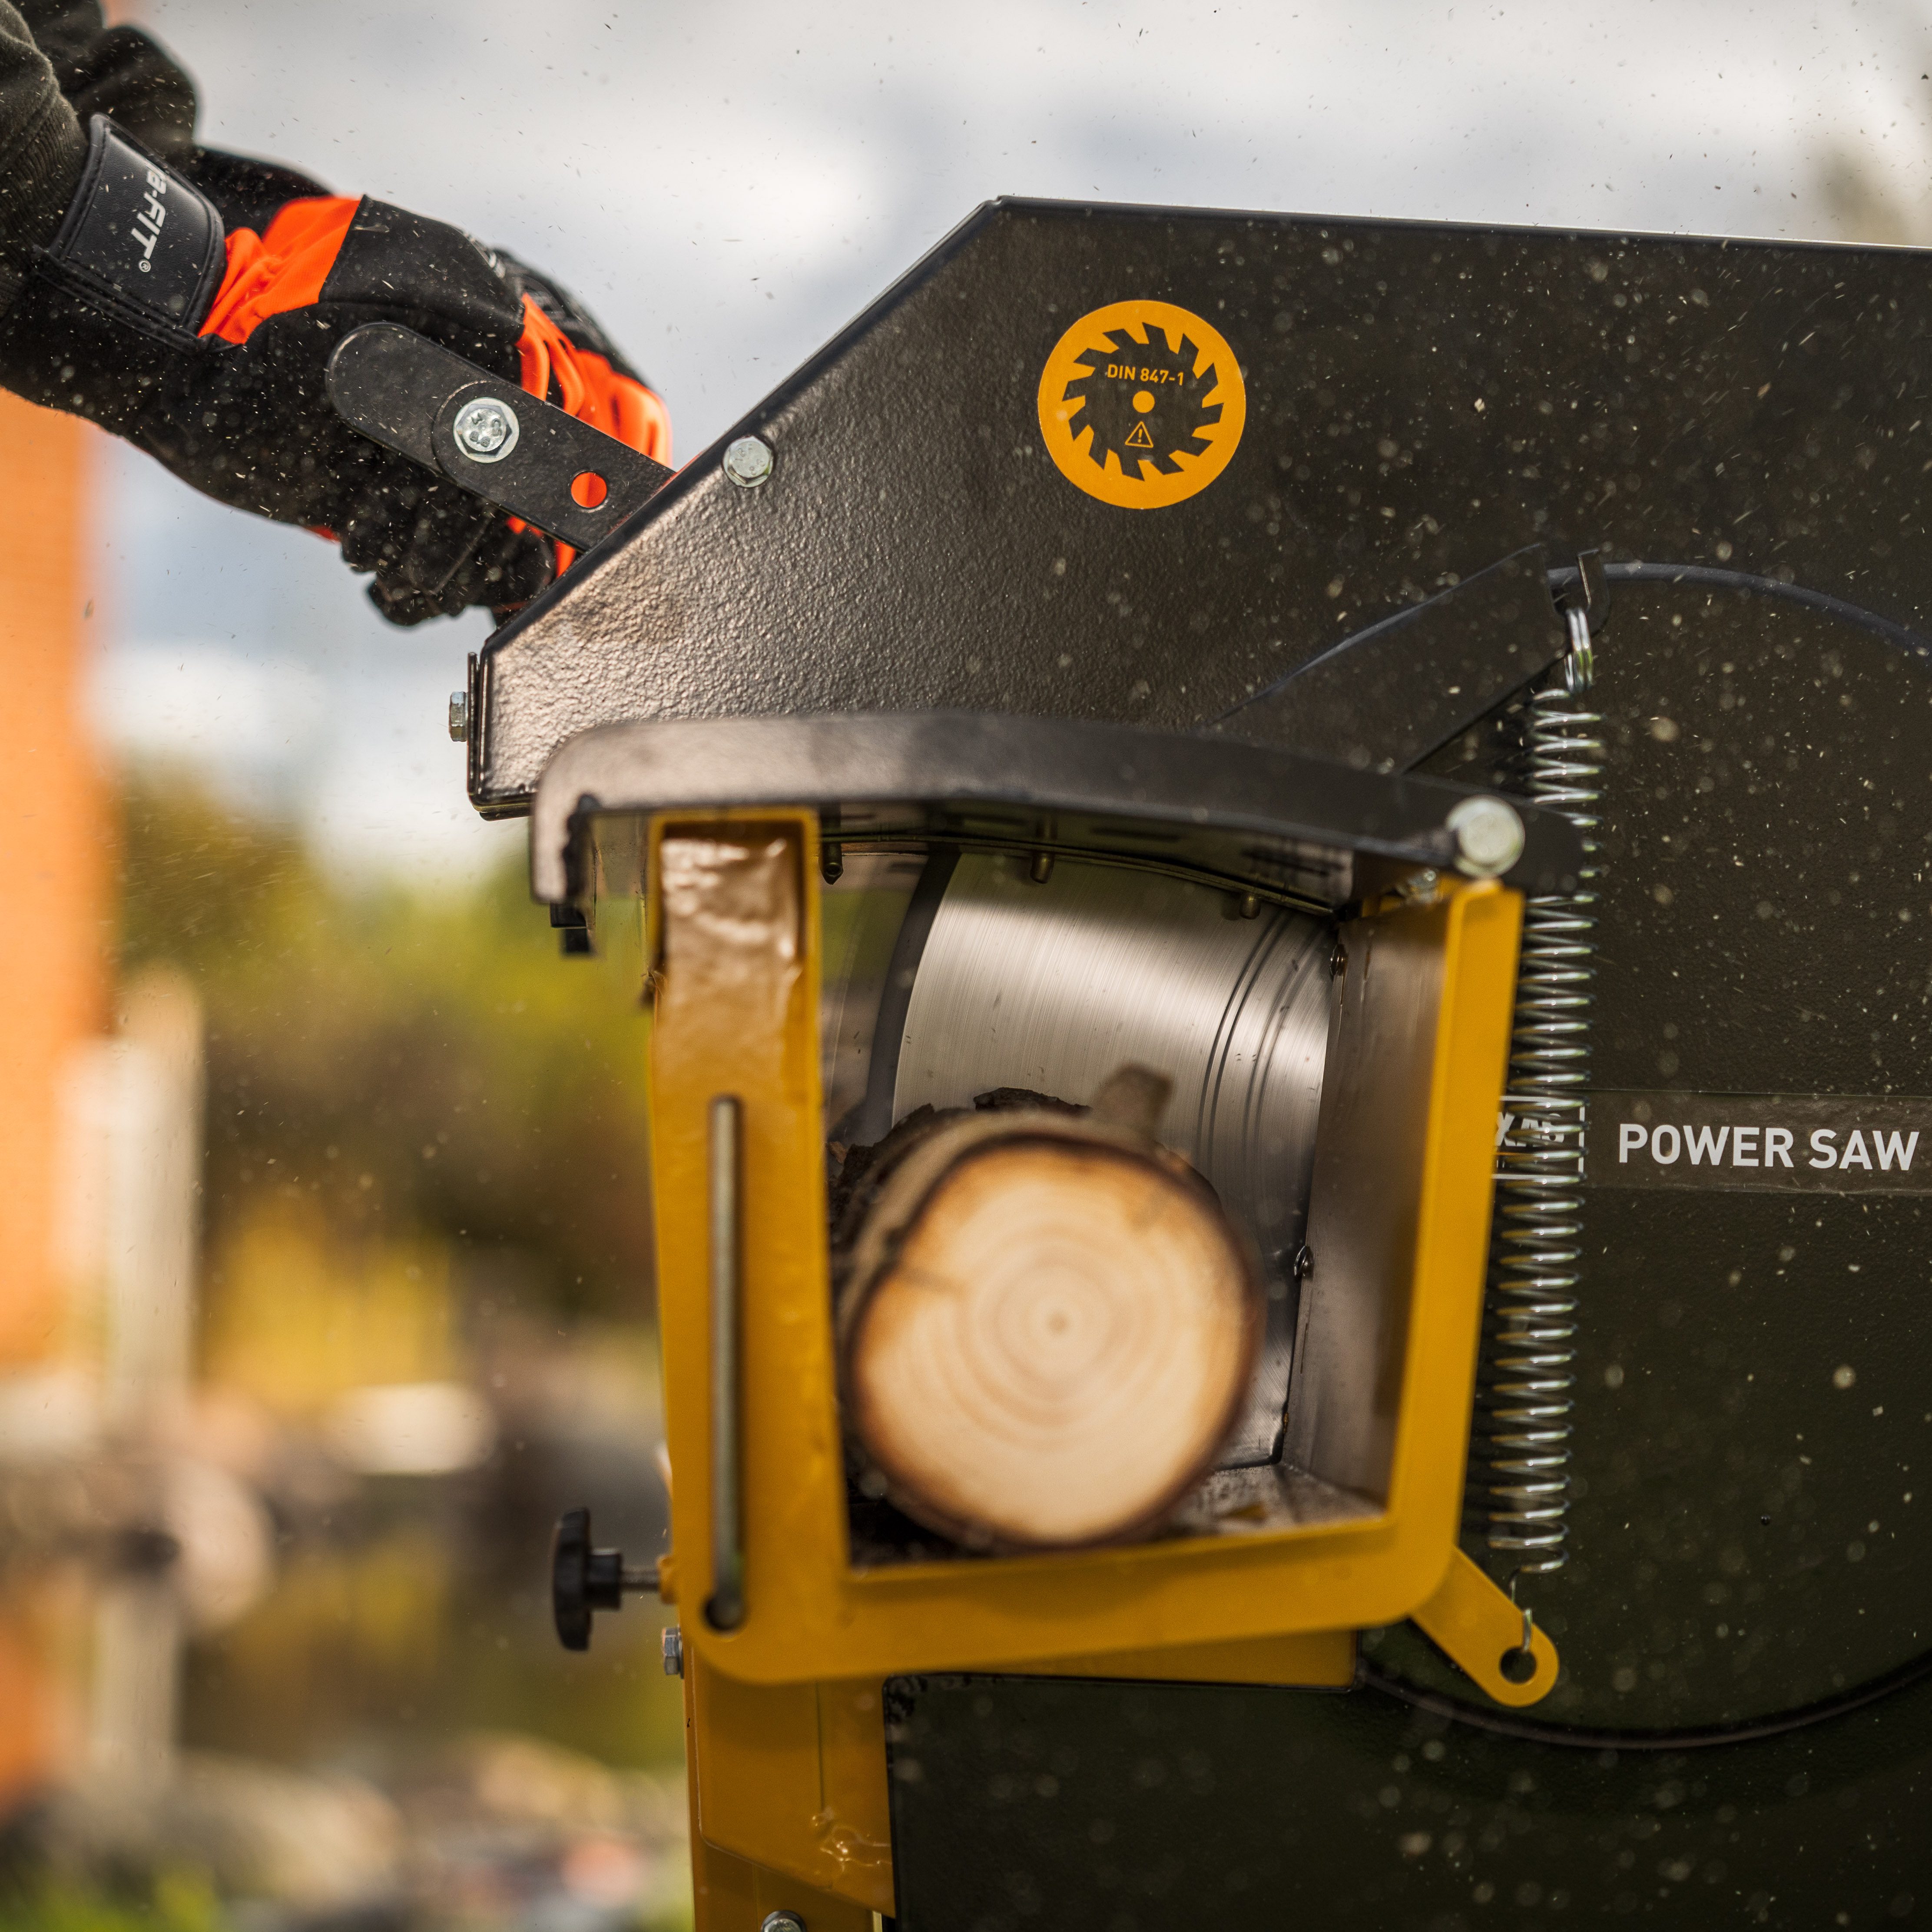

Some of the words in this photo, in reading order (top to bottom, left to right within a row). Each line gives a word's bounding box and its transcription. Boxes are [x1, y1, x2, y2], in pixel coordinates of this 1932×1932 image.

[1107, 364, 1136, 381] DIN
[1140, 368, 1184, 386] 847-1
[1619, 1123, 1794, 1168] POWER
[1808, 1128, 1919, 1171] SAW
